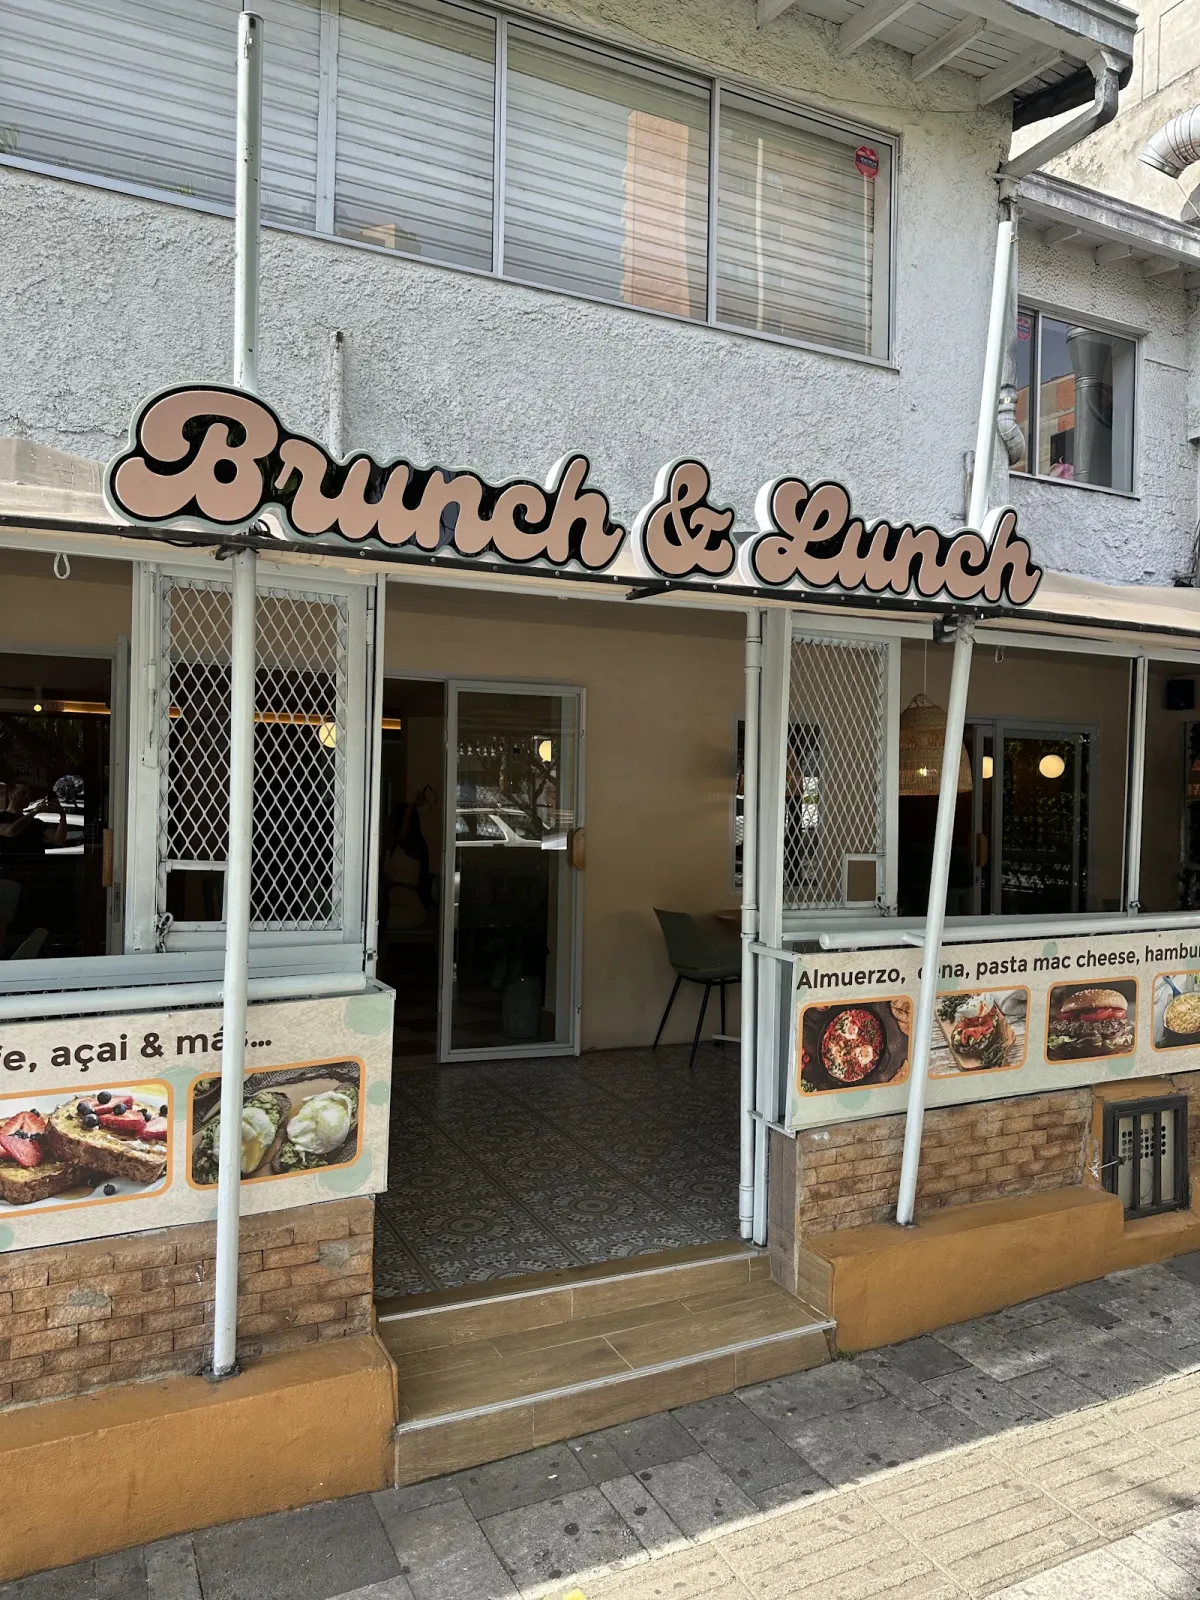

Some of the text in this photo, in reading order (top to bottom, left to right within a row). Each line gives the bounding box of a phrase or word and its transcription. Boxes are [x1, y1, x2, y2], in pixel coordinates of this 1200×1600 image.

[113, 388, 1042, 606] Brunch & Lunch
[796, 942, 1200, 990] Almuerzo, na, pasta mac cheese, hambu
[51, 1033, 128, 1072] açai
[140, 1032, 165, 1058] &
[176, 1025, 272, 1055] má...
